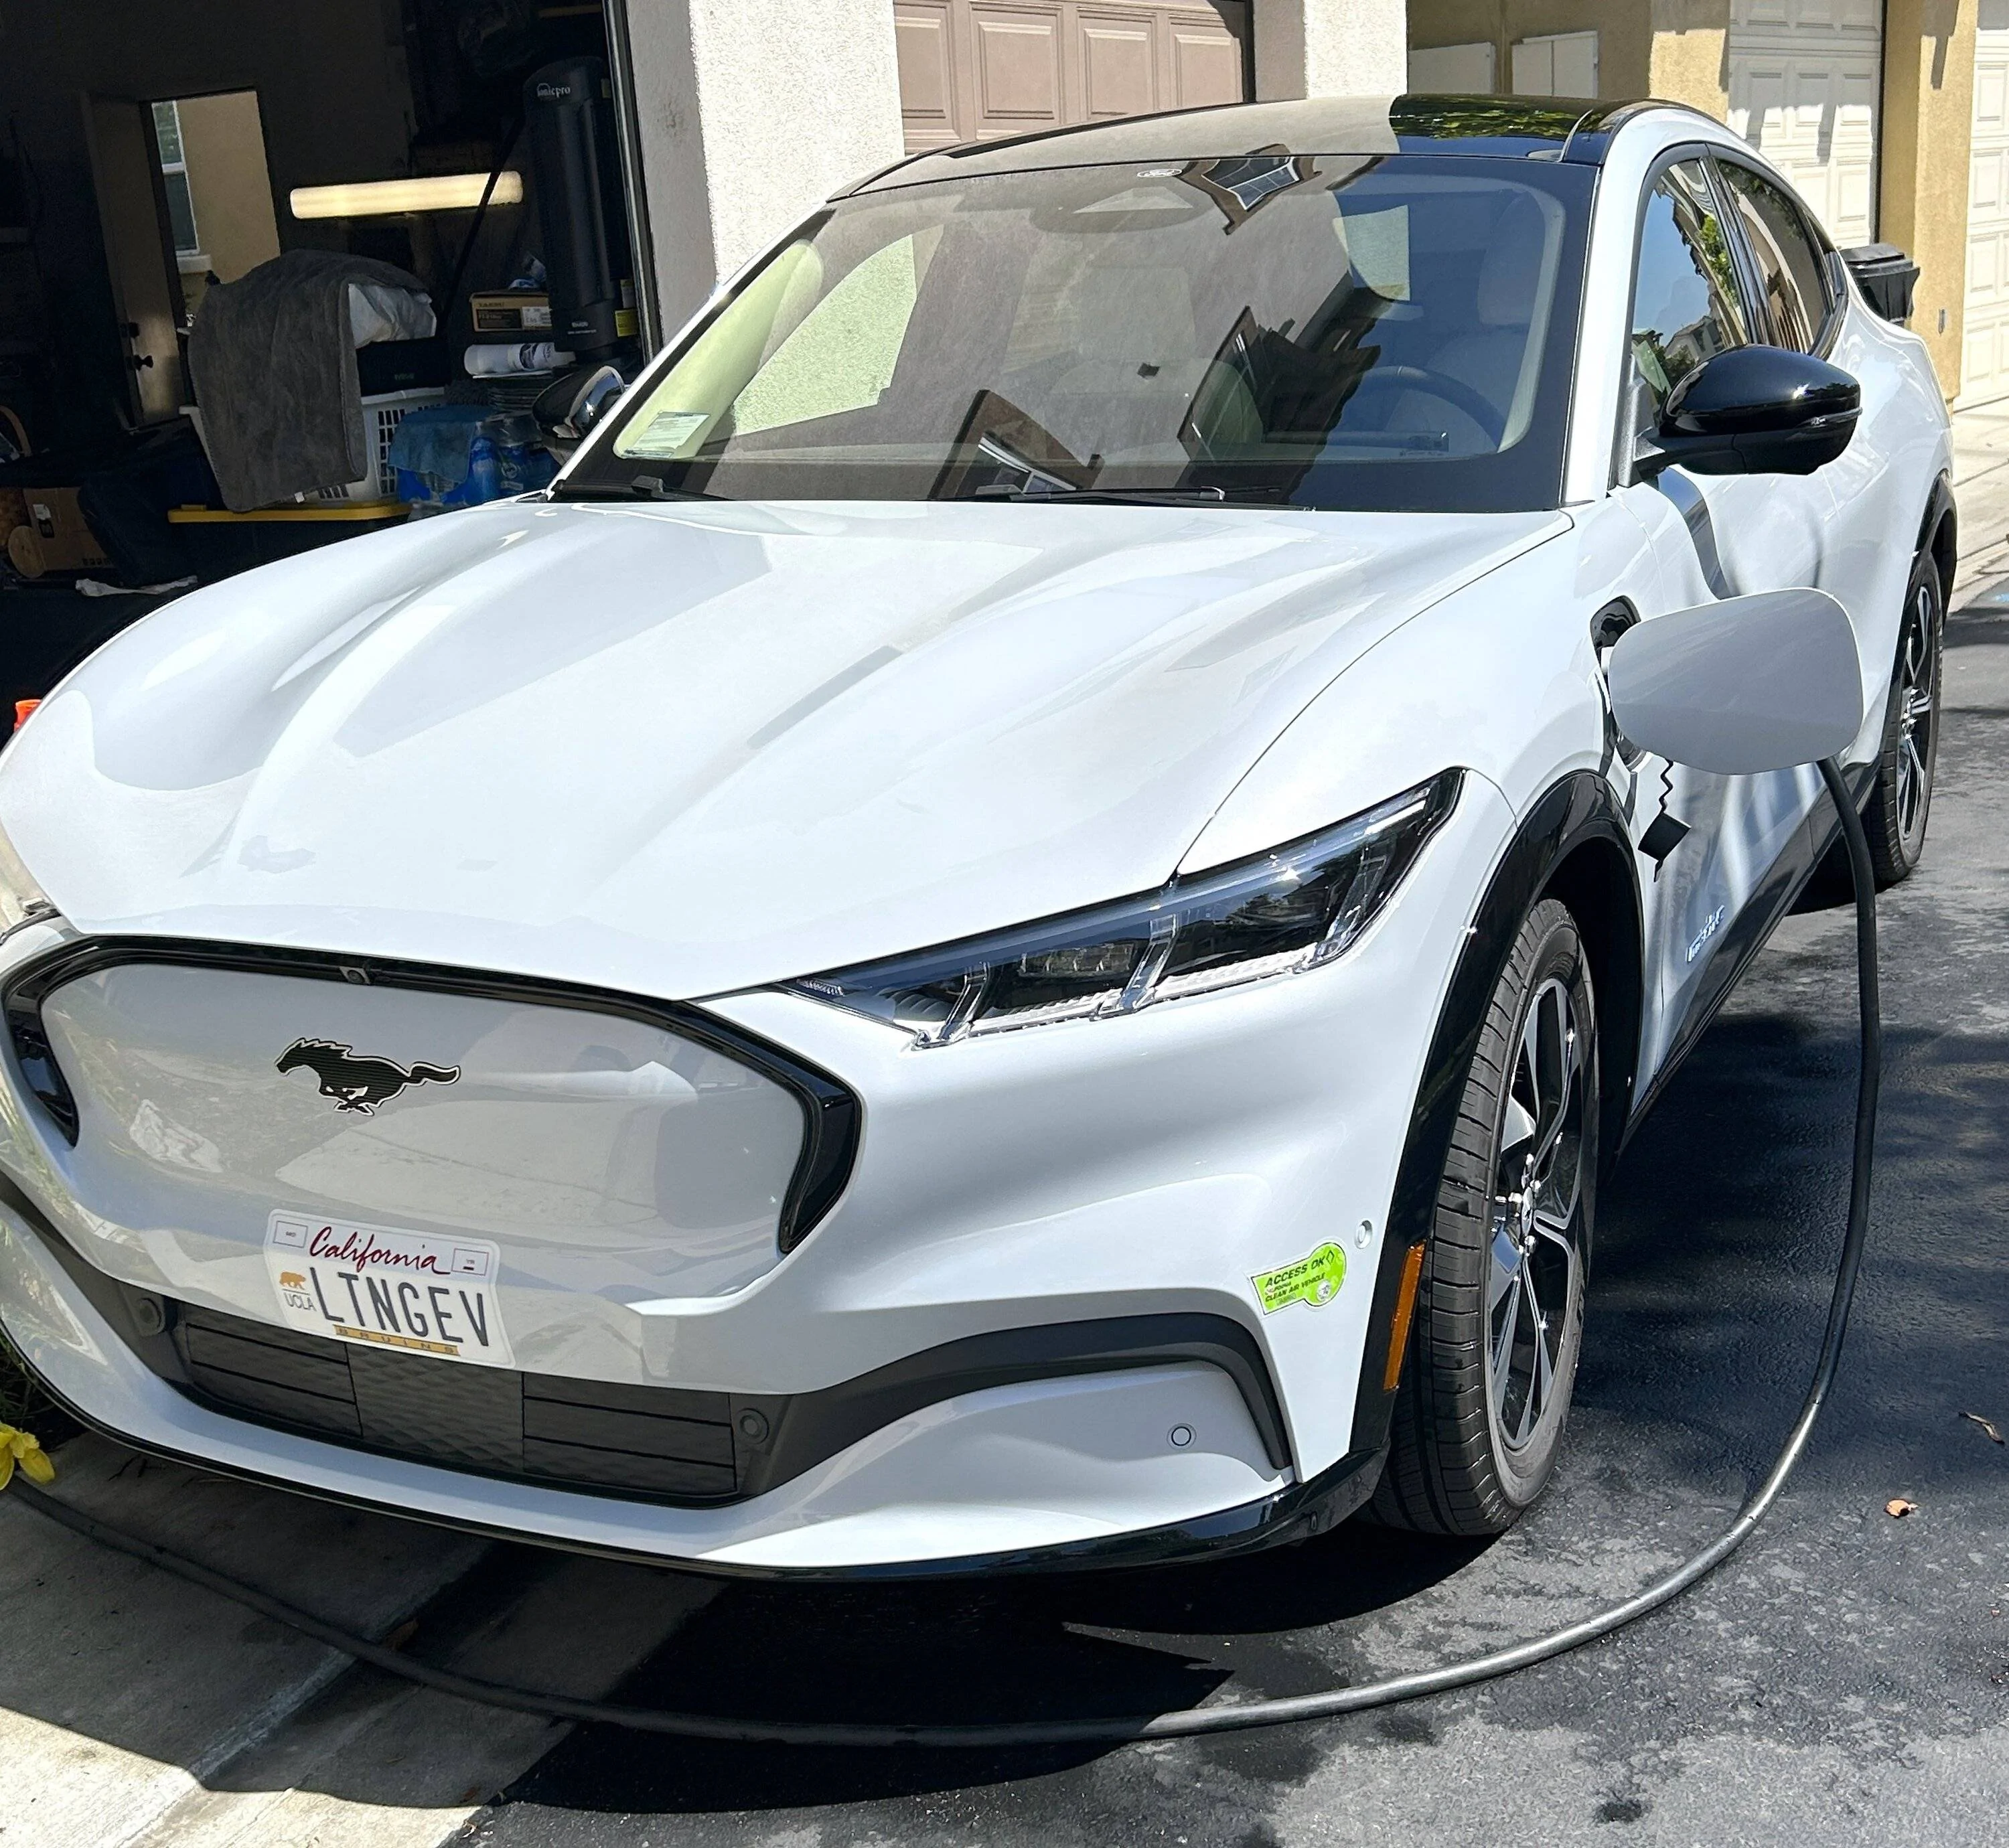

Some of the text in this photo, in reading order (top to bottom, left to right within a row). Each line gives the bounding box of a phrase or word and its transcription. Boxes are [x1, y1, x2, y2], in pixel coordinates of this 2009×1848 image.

[309, 1226, 451, 1276] California
[1264, 1255, 1326, 1288] ACCESS OK
[285, 1293, 317, 1312] UCLA
[309, 1266, 490, 1347] LTNGEV
[1265, 1288, 1287, 1303] CLEAN
